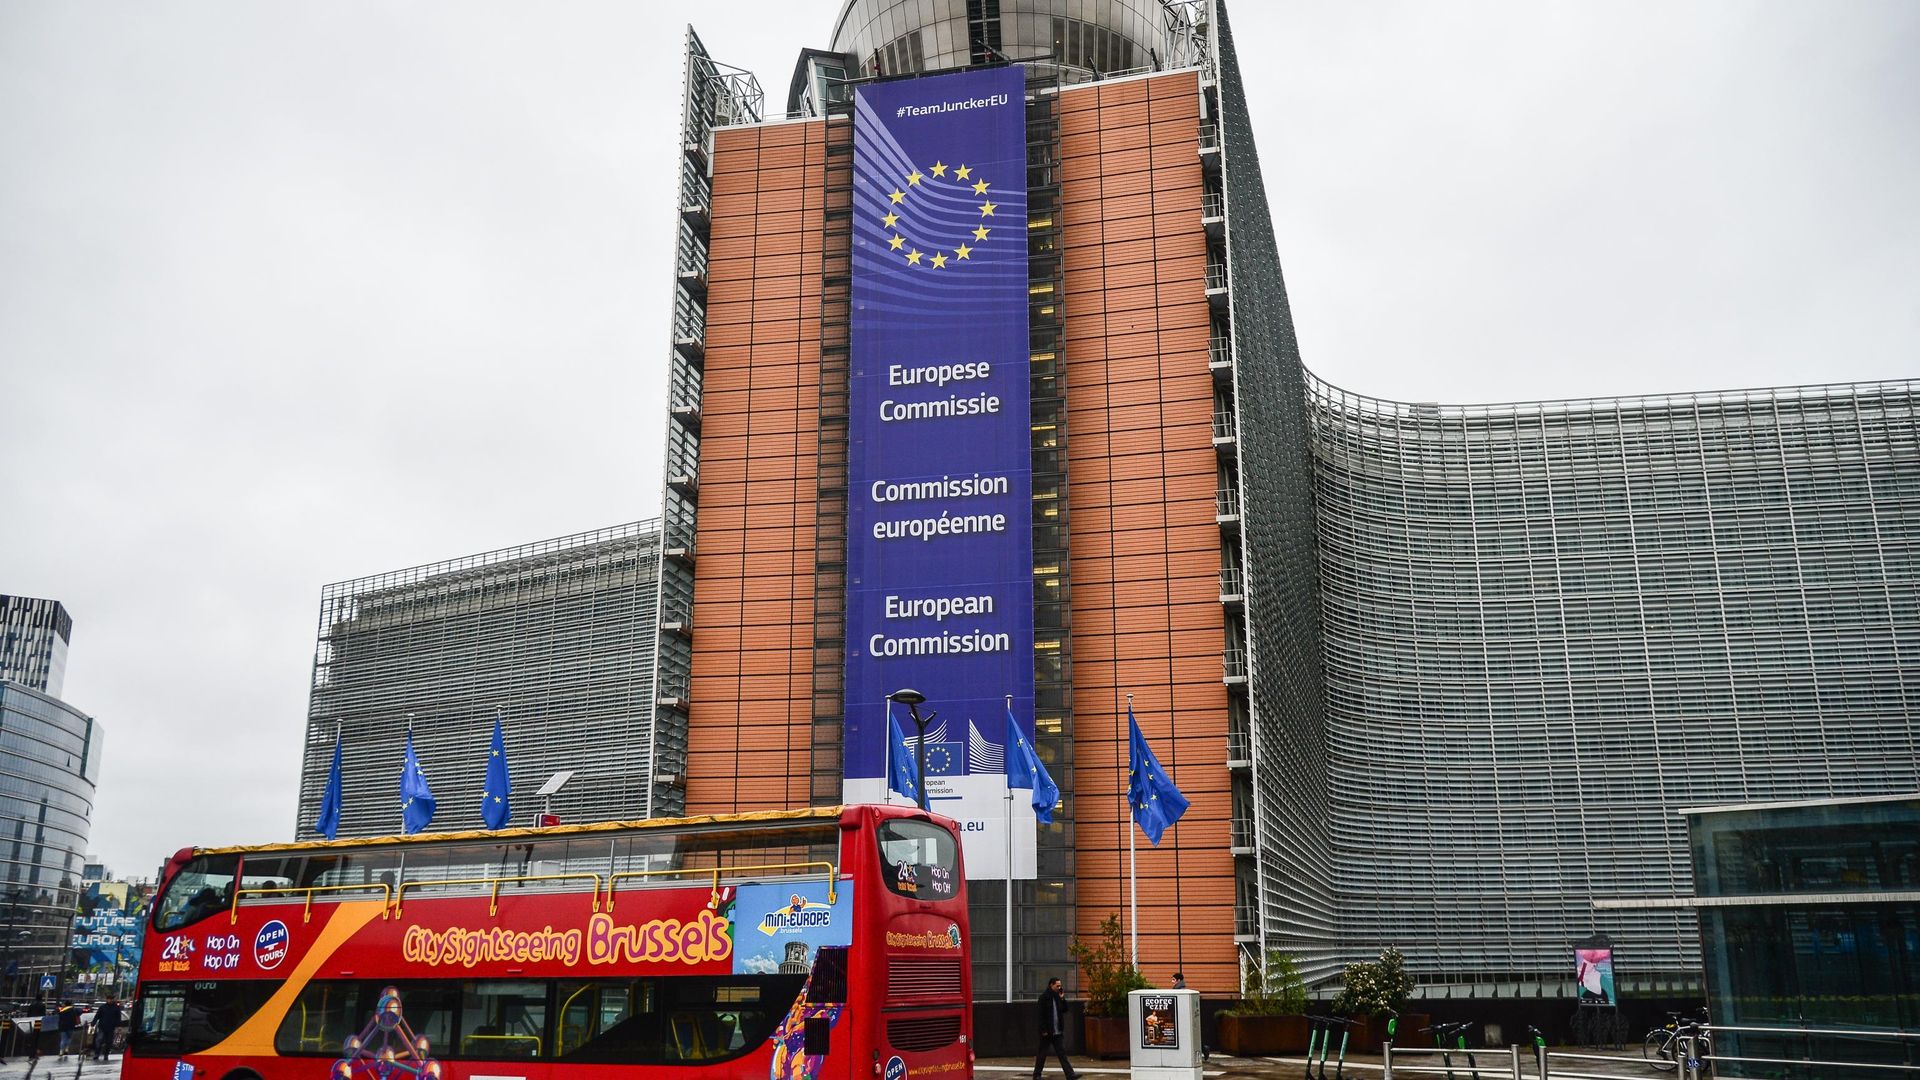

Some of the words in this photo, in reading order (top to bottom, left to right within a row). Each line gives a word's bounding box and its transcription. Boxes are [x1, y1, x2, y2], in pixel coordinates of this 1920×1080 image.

[896, 94, 1008, 118] #TeamJunckerEU
[889, 361, 990, 387] Europese
[879, 392, 1000, 421] Commissie
[871, 473, 1008, 502] Commission
[873, 510, 1006, 541] européenne
[885, 594, 993, 621] European
[869, 629, 1009, 657] Commission
[925, 779, 946, 787] opean
[927, 786, 954, 794] mission
[93, 908, 118, 916] THE
[75, 916, 136, 926] FUTURE
[206, 936, 225, 950] Hop
[226, 934, 240, 949] On
[259, 928, 285, 943] OPEN
[587, 909, 733, 965] Brussels
[162, 936, 180, 959] 24
[203, 954, 223, 969] Hop
[224, 953, 240, 968] Off
[259, 949, 284, 963] TOURS
[1145, 998, 1172, 1007] george
[887, 1063, 903, 1078] OPEN
